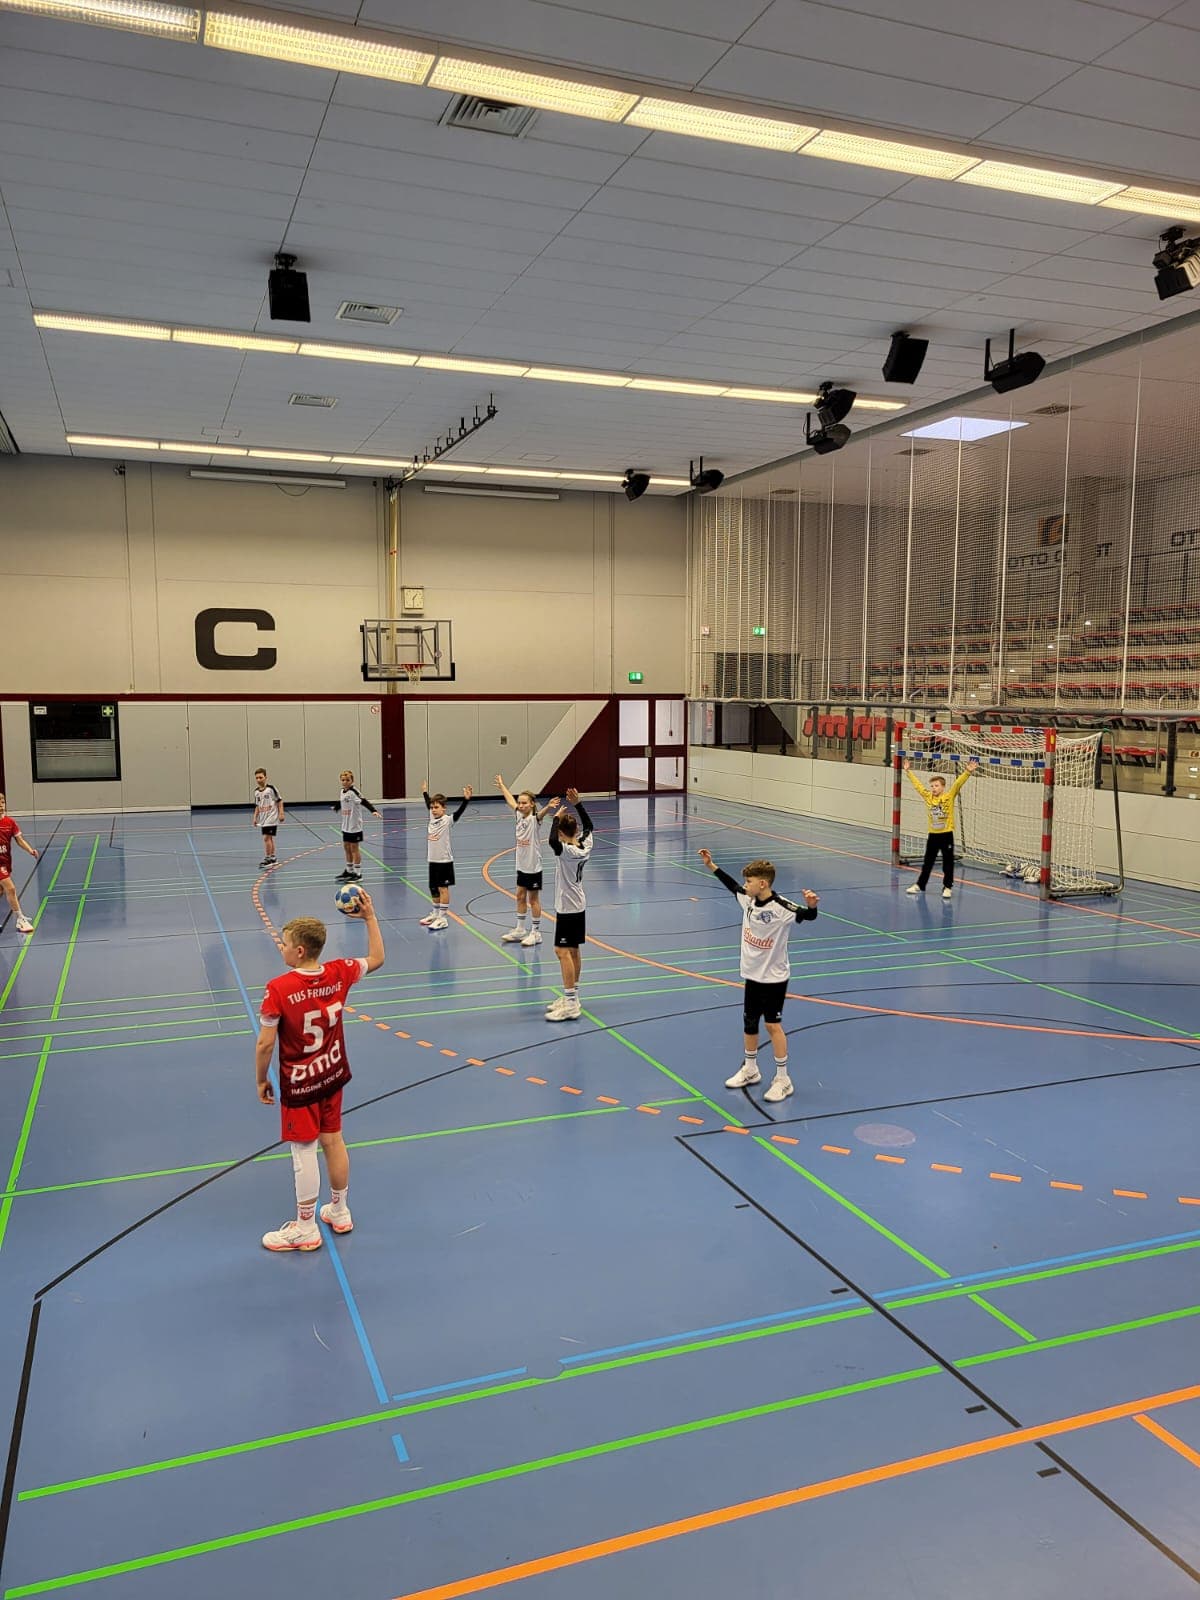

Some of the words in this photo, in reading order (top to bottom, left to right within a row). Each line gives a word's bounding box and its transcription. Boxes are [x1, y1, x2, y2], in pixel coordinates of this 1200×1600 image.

[195, 607, 277, 671] C
[743, 927, 774, 949] Brandt
[287, 990, 306, 1005] TUS
